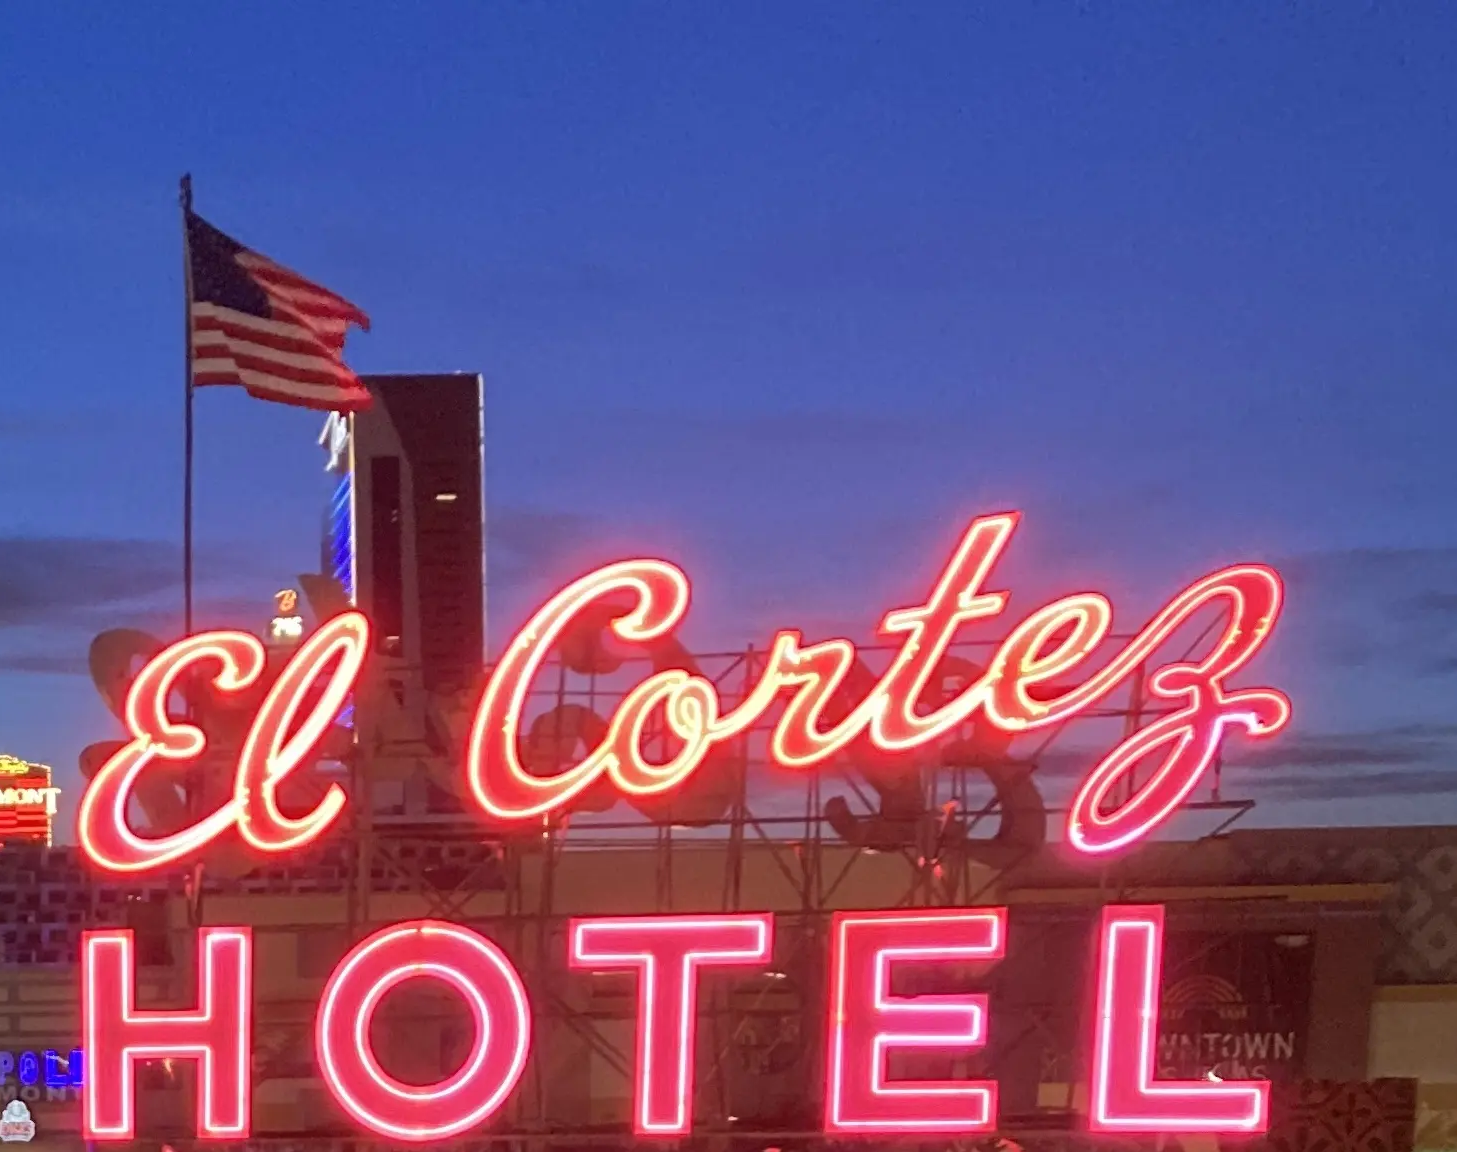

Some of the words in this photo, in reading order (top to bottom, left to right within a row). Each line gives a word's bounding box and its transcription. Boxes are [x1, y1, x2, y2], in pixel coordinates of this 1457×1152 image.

[78, 611, 370, 872] El
[468, 510, 1292, 855] Cortez
[82, 904, 1271, 1142] HOTEL
